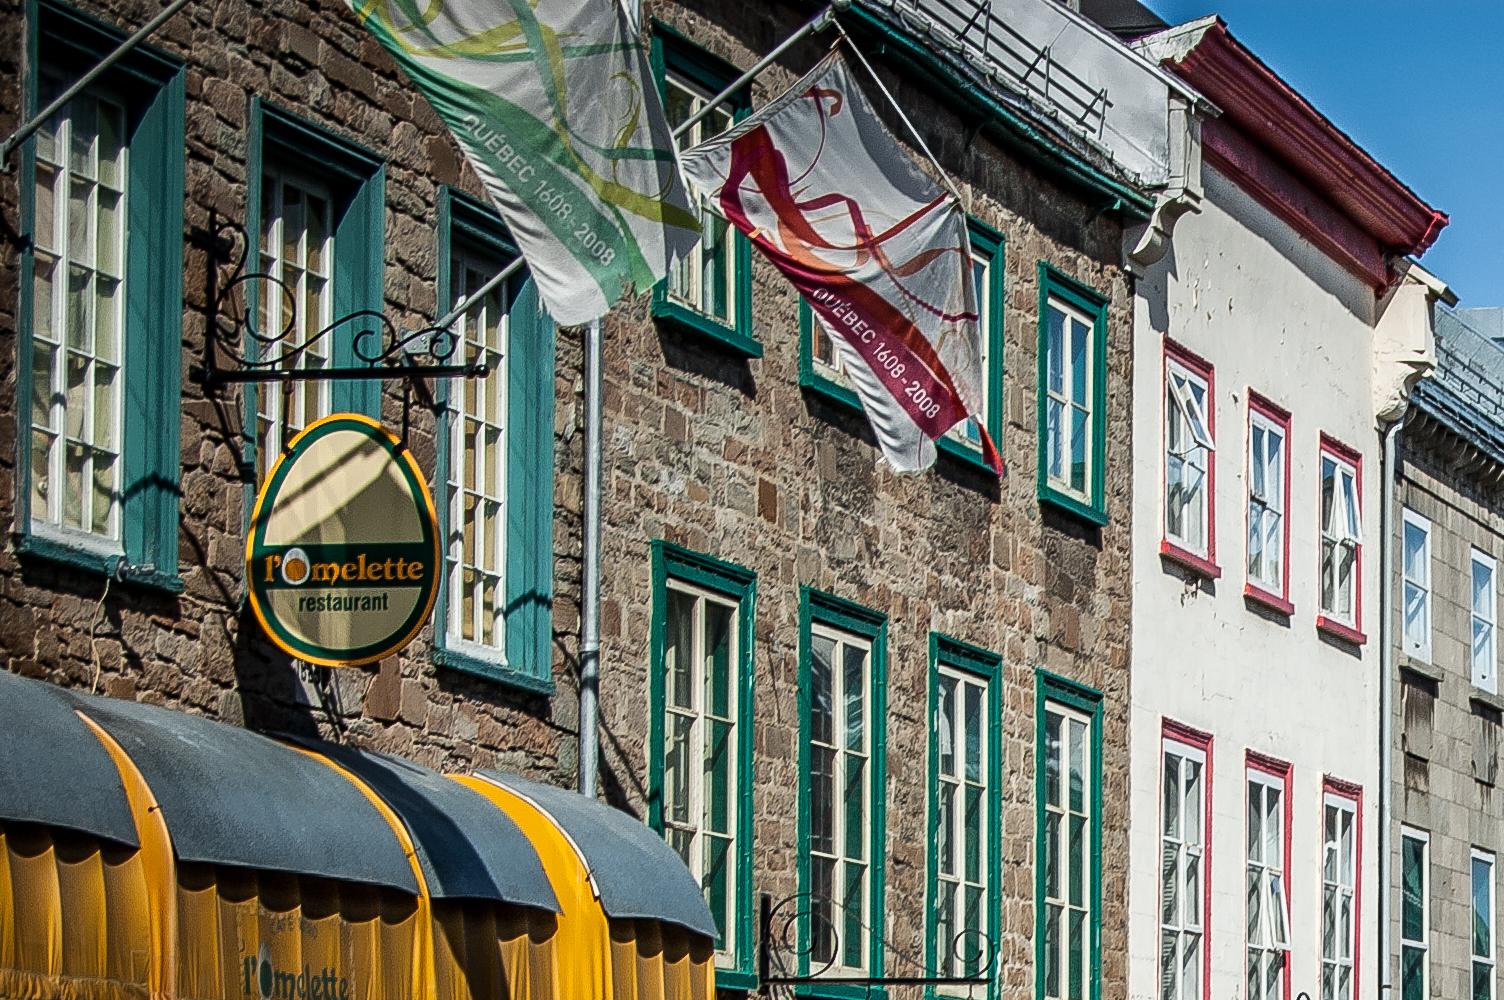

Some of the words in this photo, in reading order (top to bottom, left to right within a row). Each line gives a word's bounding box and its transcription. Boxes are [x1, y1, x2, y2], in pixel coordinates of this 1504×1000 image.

[464, 114, 537, 184] QUÉBEC
[813, 287, 877, 344] QUÉBEC
[298, 592, 390, 612] restaurant
